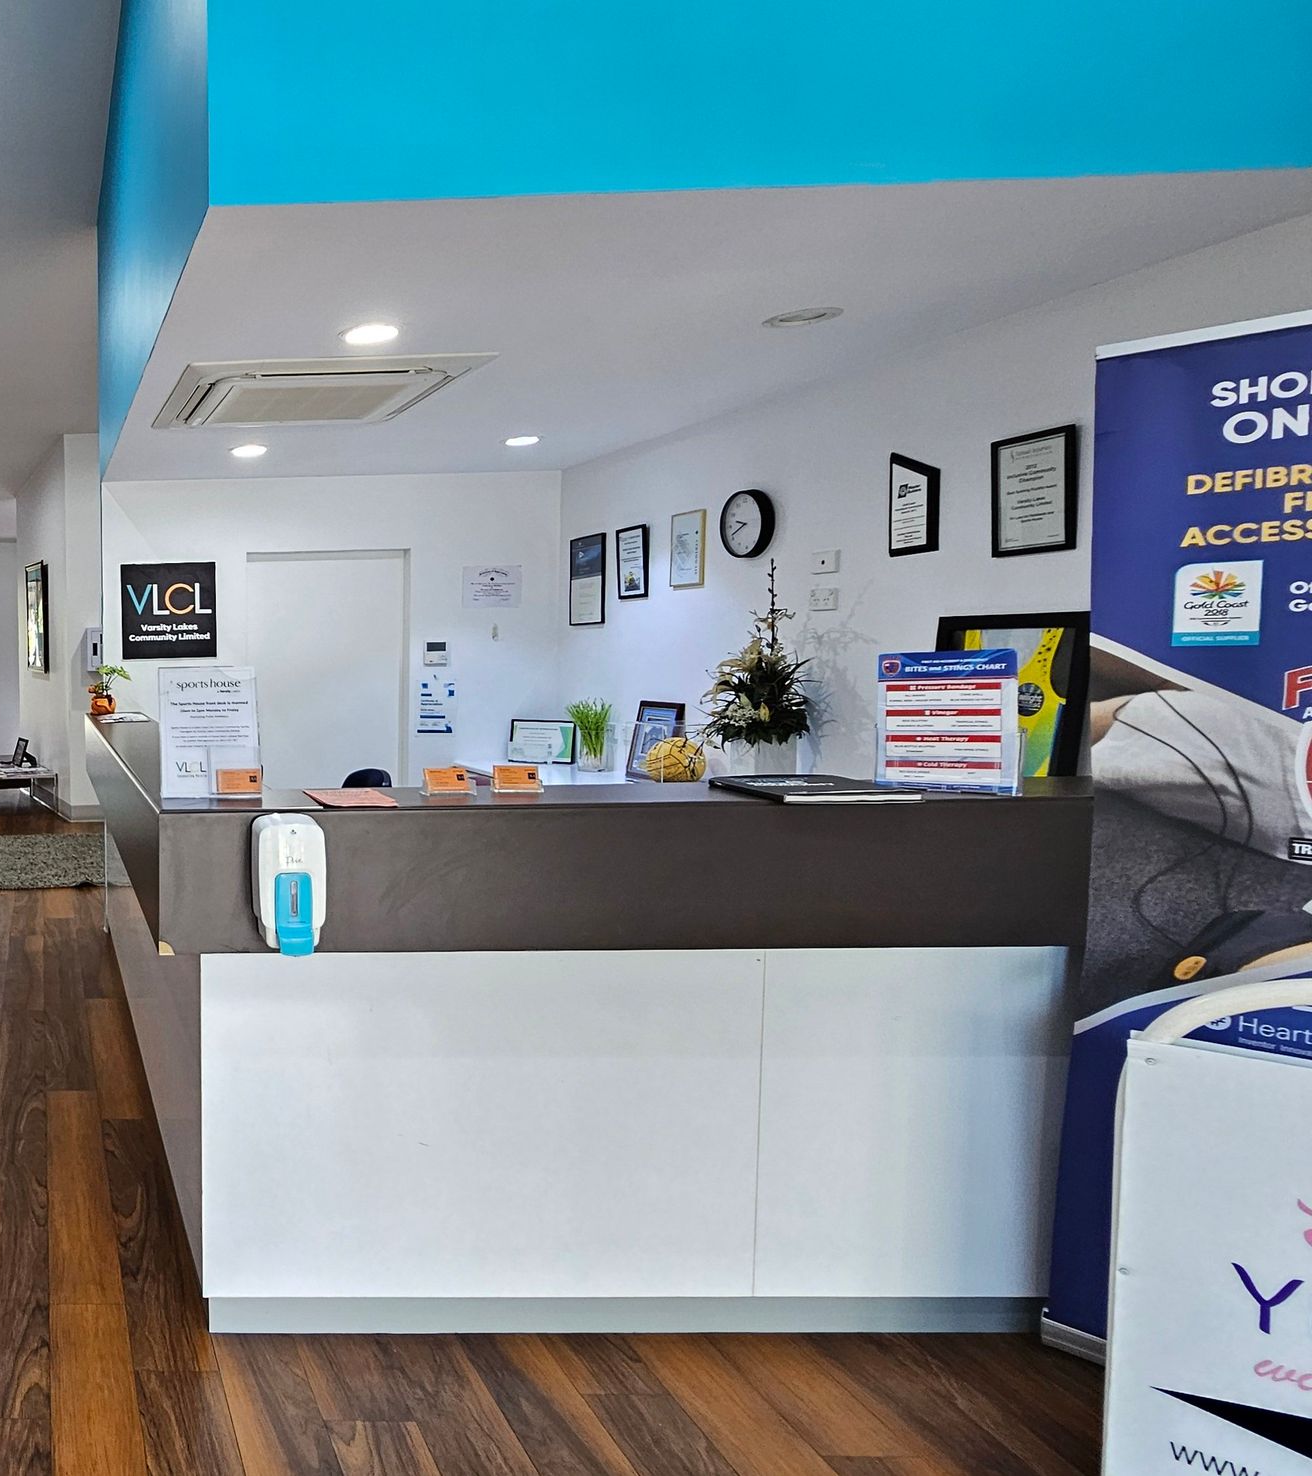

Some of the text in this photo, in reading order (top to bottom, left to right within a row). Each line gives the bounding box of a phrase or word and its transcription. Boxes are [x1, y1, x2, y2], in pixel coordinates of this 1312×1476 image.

[1210, 371, 1312, 407] SHO
[126, 582, 213, 616] VLCL
[1183, 600, 1249, 610] Gold Coast
[141, 622, 199, 633] Varsity Lakes
[128, 632, 211, 642] Community Limited
[904, 665, 928, 673] BITES
[943, 664, 975, 672] STINGS
[975, 663, 1007, 671] CHART
[1238, 1015, 1312, 1045] Heart
